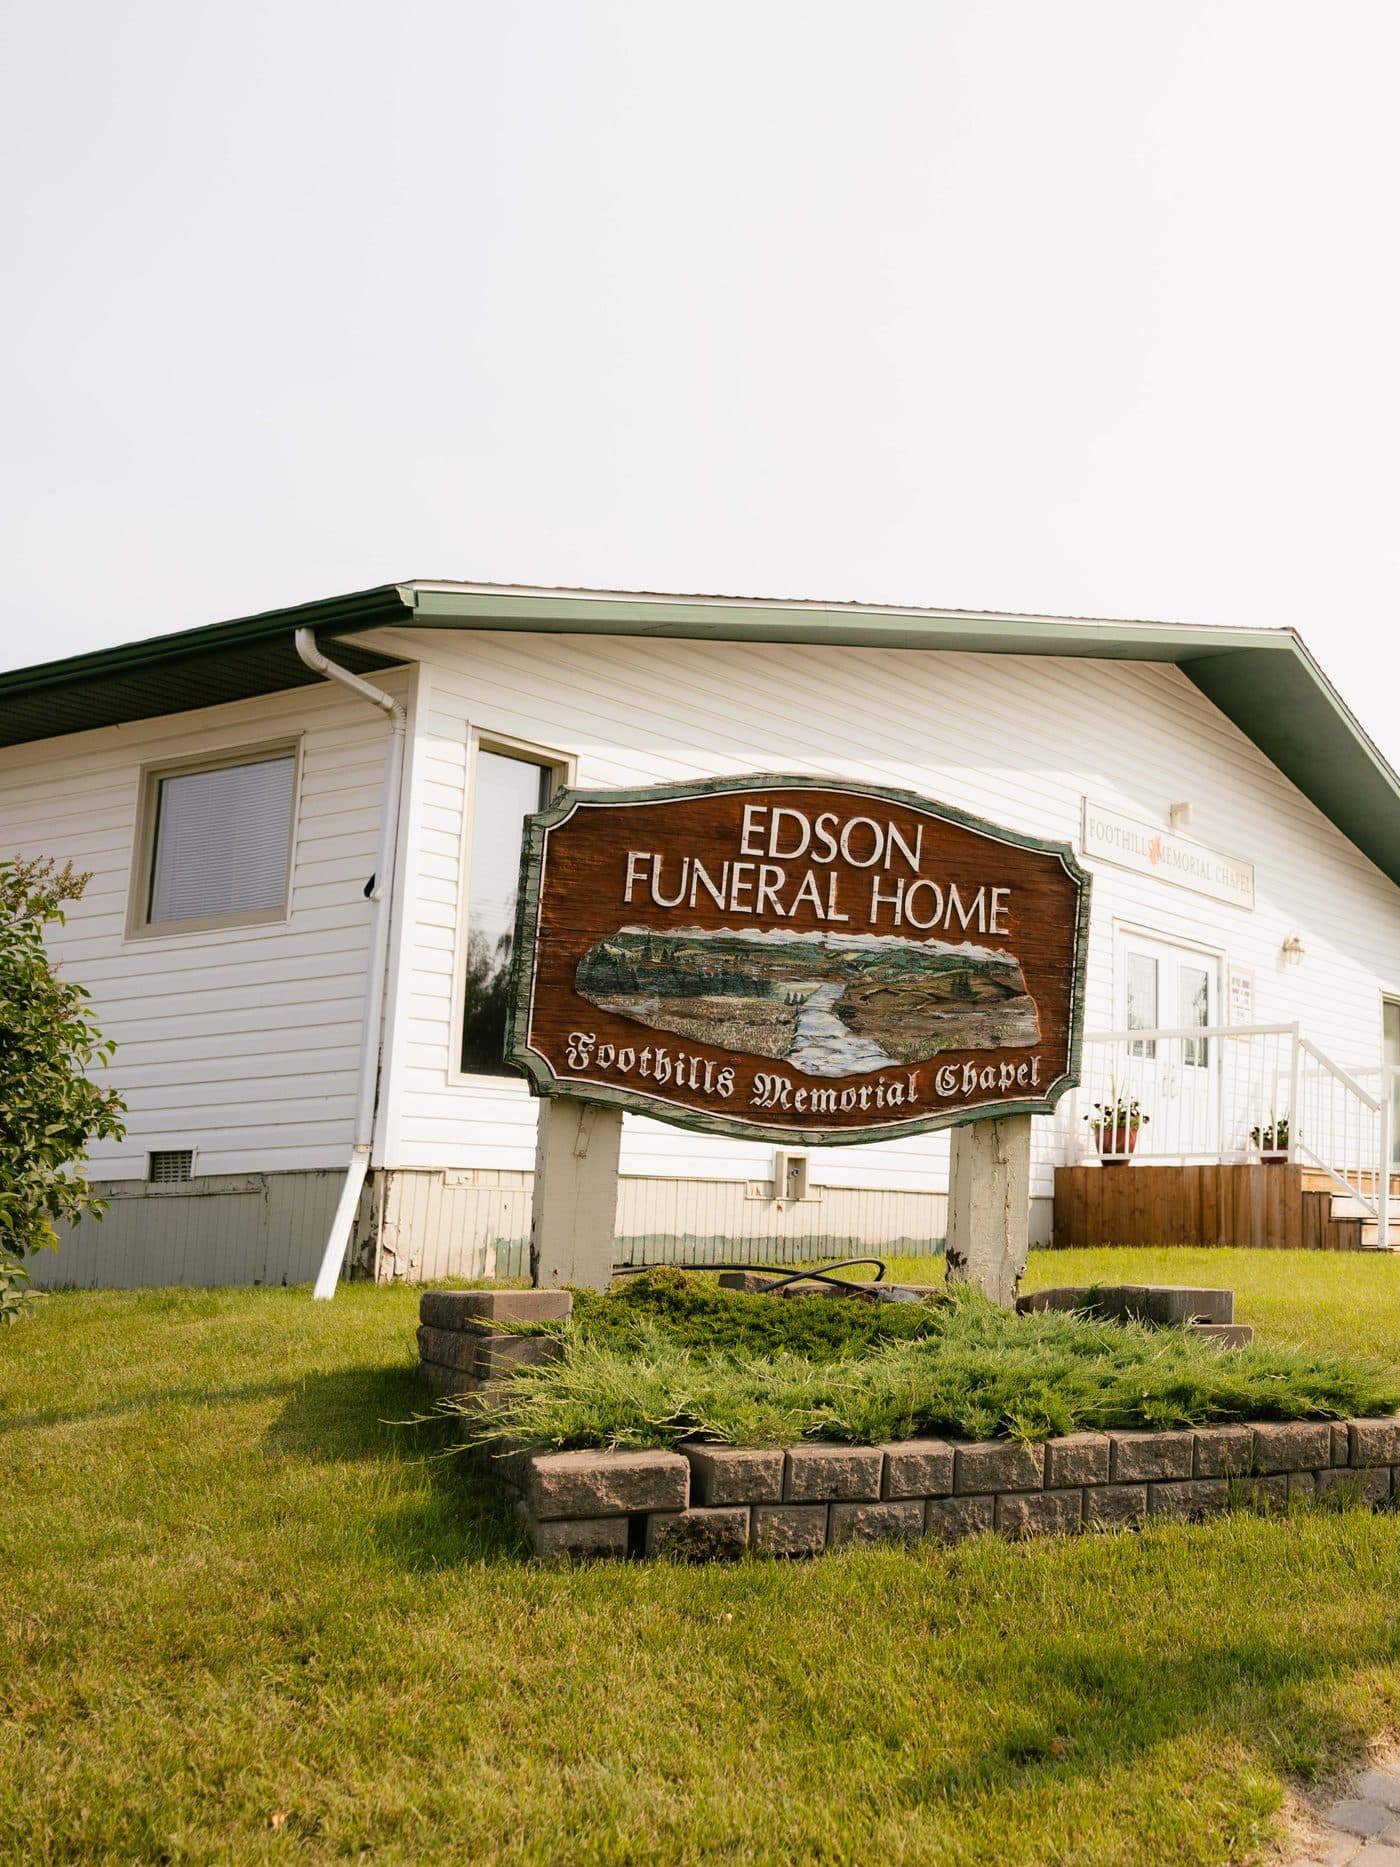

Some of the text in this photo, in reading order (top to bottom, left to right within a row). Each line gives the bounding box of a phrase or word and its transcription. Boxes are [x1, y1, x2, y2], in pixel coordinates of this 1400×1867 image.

[740, 804, 924, 872] EDSON
[623, 851, 1012, 936] FUNERAL HOME
[1215, 864, 1251, 893] CHAPEL
[565, 1032, 1042, 1113] Foothills Memorial Chapel
